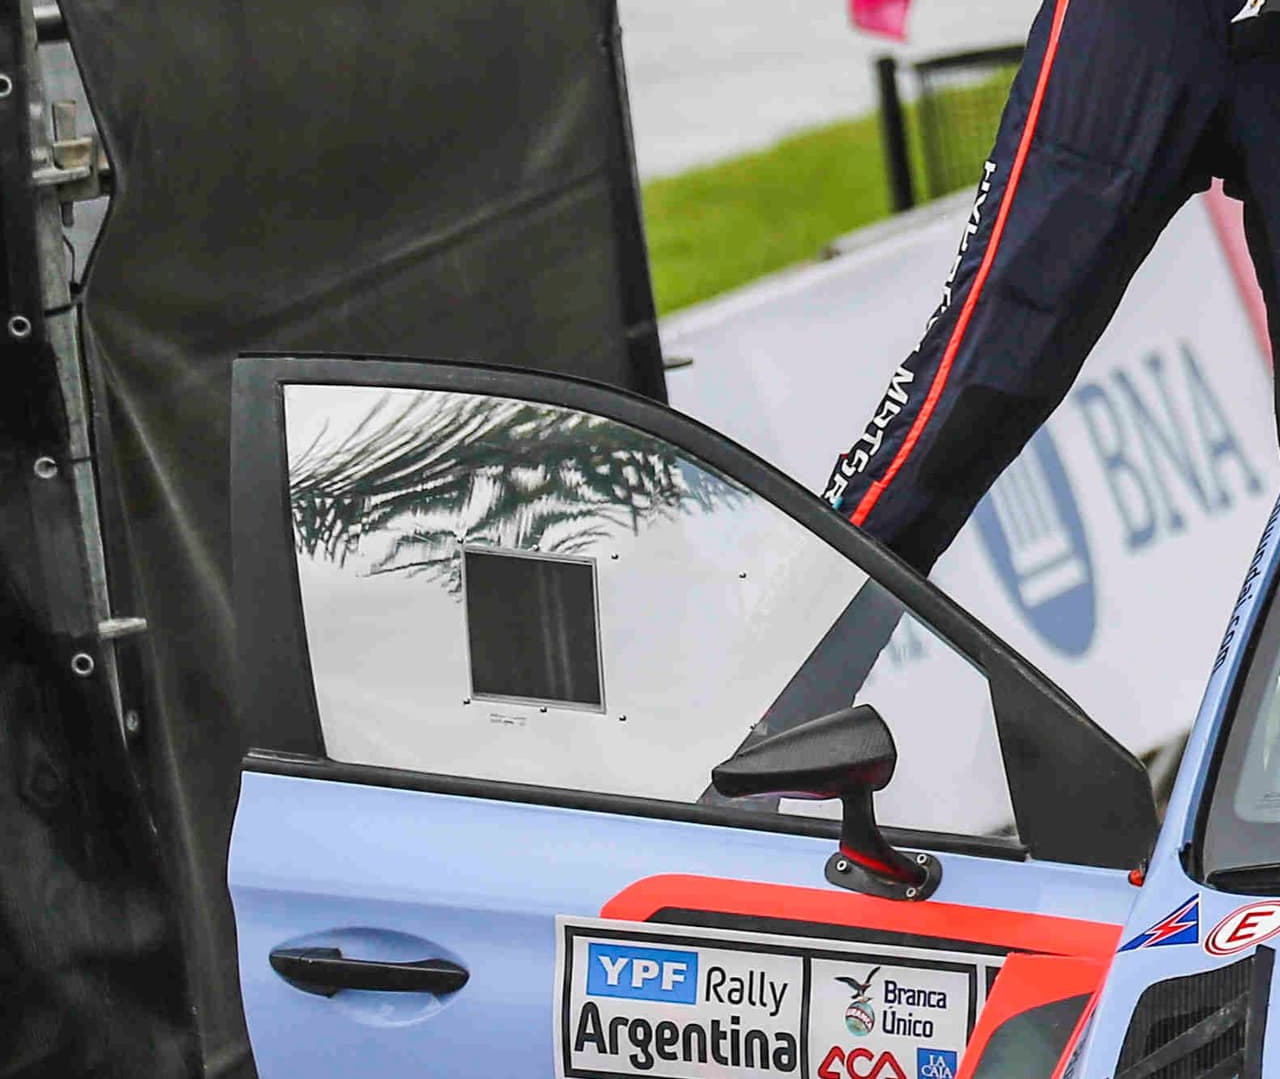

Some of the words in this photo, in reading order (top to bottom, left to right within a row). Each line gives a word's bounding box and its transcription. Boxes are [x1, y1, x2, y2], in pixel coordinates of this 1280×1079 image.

[1069, 337, 1266, 554] BNA
[1227, 909, 1274, 943] E
[597, 954, 690, 991] YPF
[704, 966, 789, 1017] Rally
[883, 980, 947, 1009] Branca
[574, 1000, 797, 1072] Argentina
[882, 1005, 934, 1038] Único
[928, 1054, 947, 1067] LA
